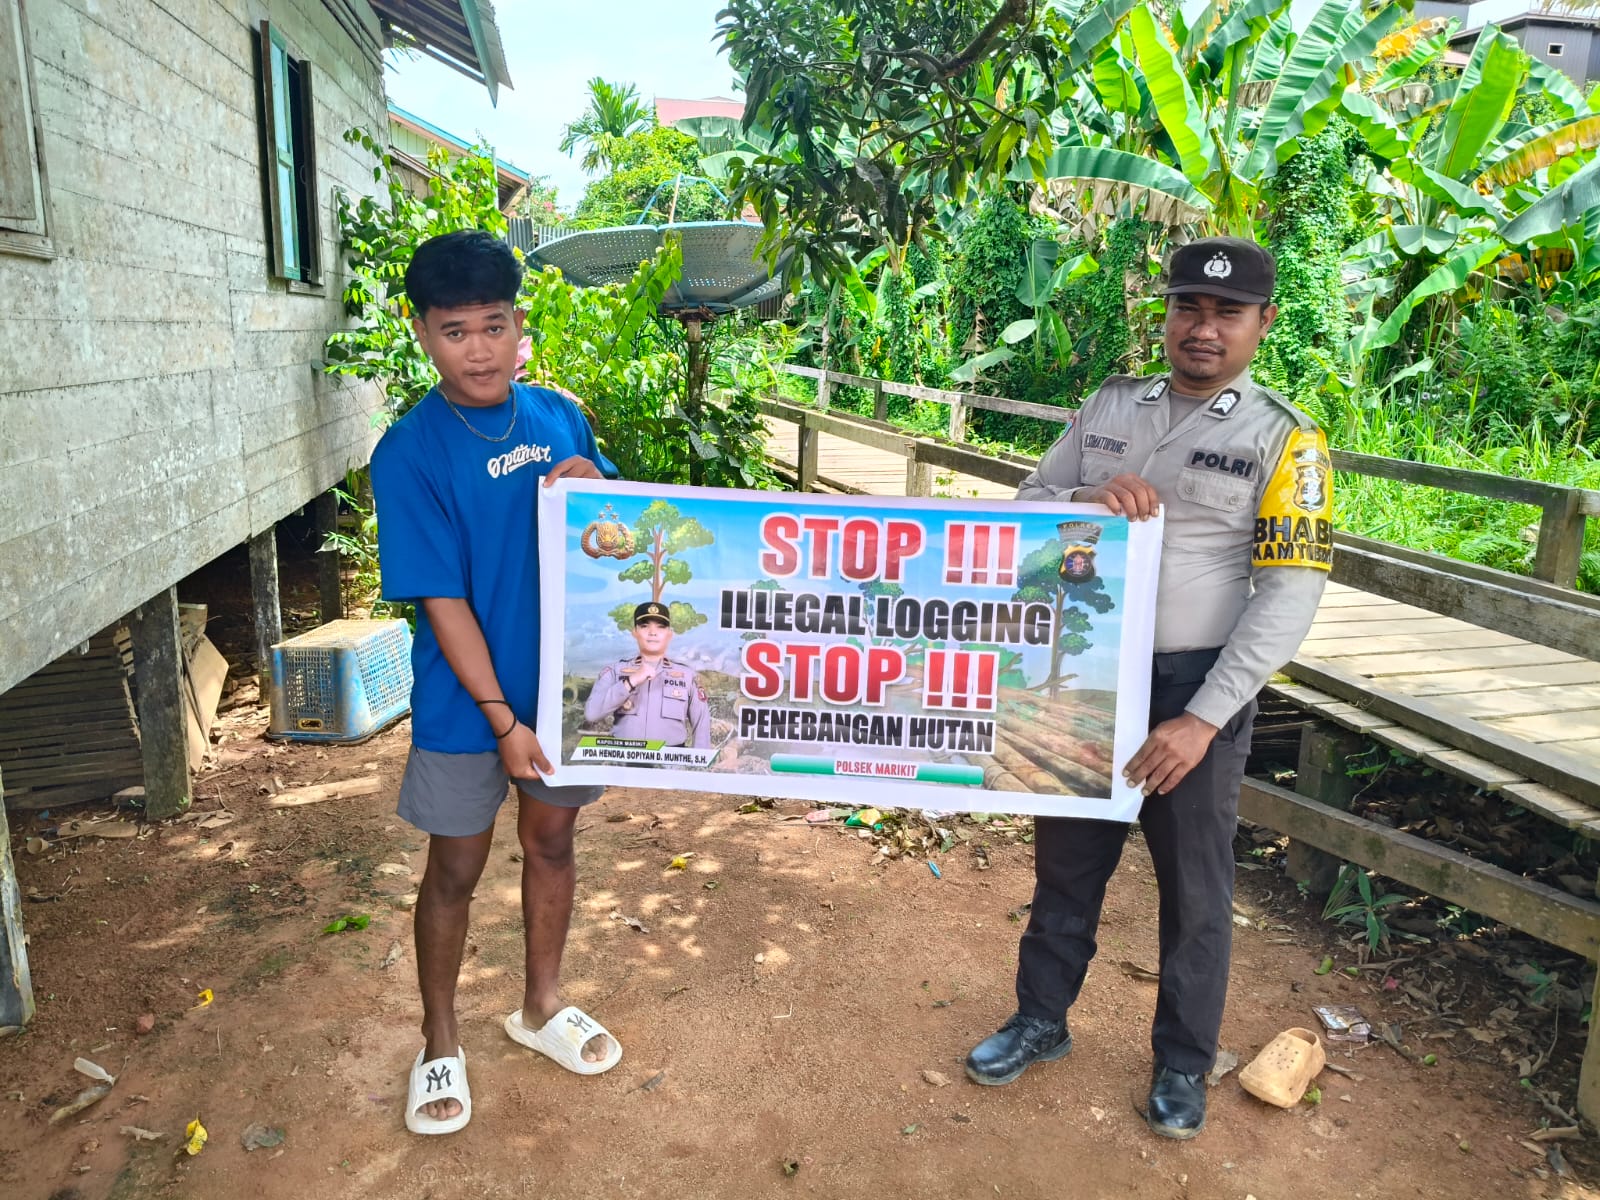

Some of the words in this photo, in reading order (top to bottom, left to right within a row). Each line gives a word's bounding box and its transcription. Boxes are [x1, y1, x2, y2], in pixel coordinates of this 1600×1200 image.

[487, 444, 551, 479] Optimist
[1191, 451, 1254, 477] POLRI
[762, 516, 923, 579] STOP
[946, 524, 1017, 585] !!!
[720, 590, 866, 636] ILLEGAL
[876, 597, 1052, 645] LOGGING
[664, 679, 686, 688] POLRI
[743, 643, 902, 704] STOP
[926, 652, 996, 710] !!!
[740, 709, 902, 747] PENEBANGAN
[909, 718, 994, 753] HUTAN
[582, 749, 598, 757] IPDA
[599, 749, 625, 759] HENDRA
[627, 751, 654, 761] SOPIYAN
[656, 752, 663, 761] D.
[664, 752, 694, 764] MUNTHE,
[695, 755, 708, 764] S.H.
[836, 760, 872, 774] POLSEK
[875, 763, 917, 777] MARIKIT
